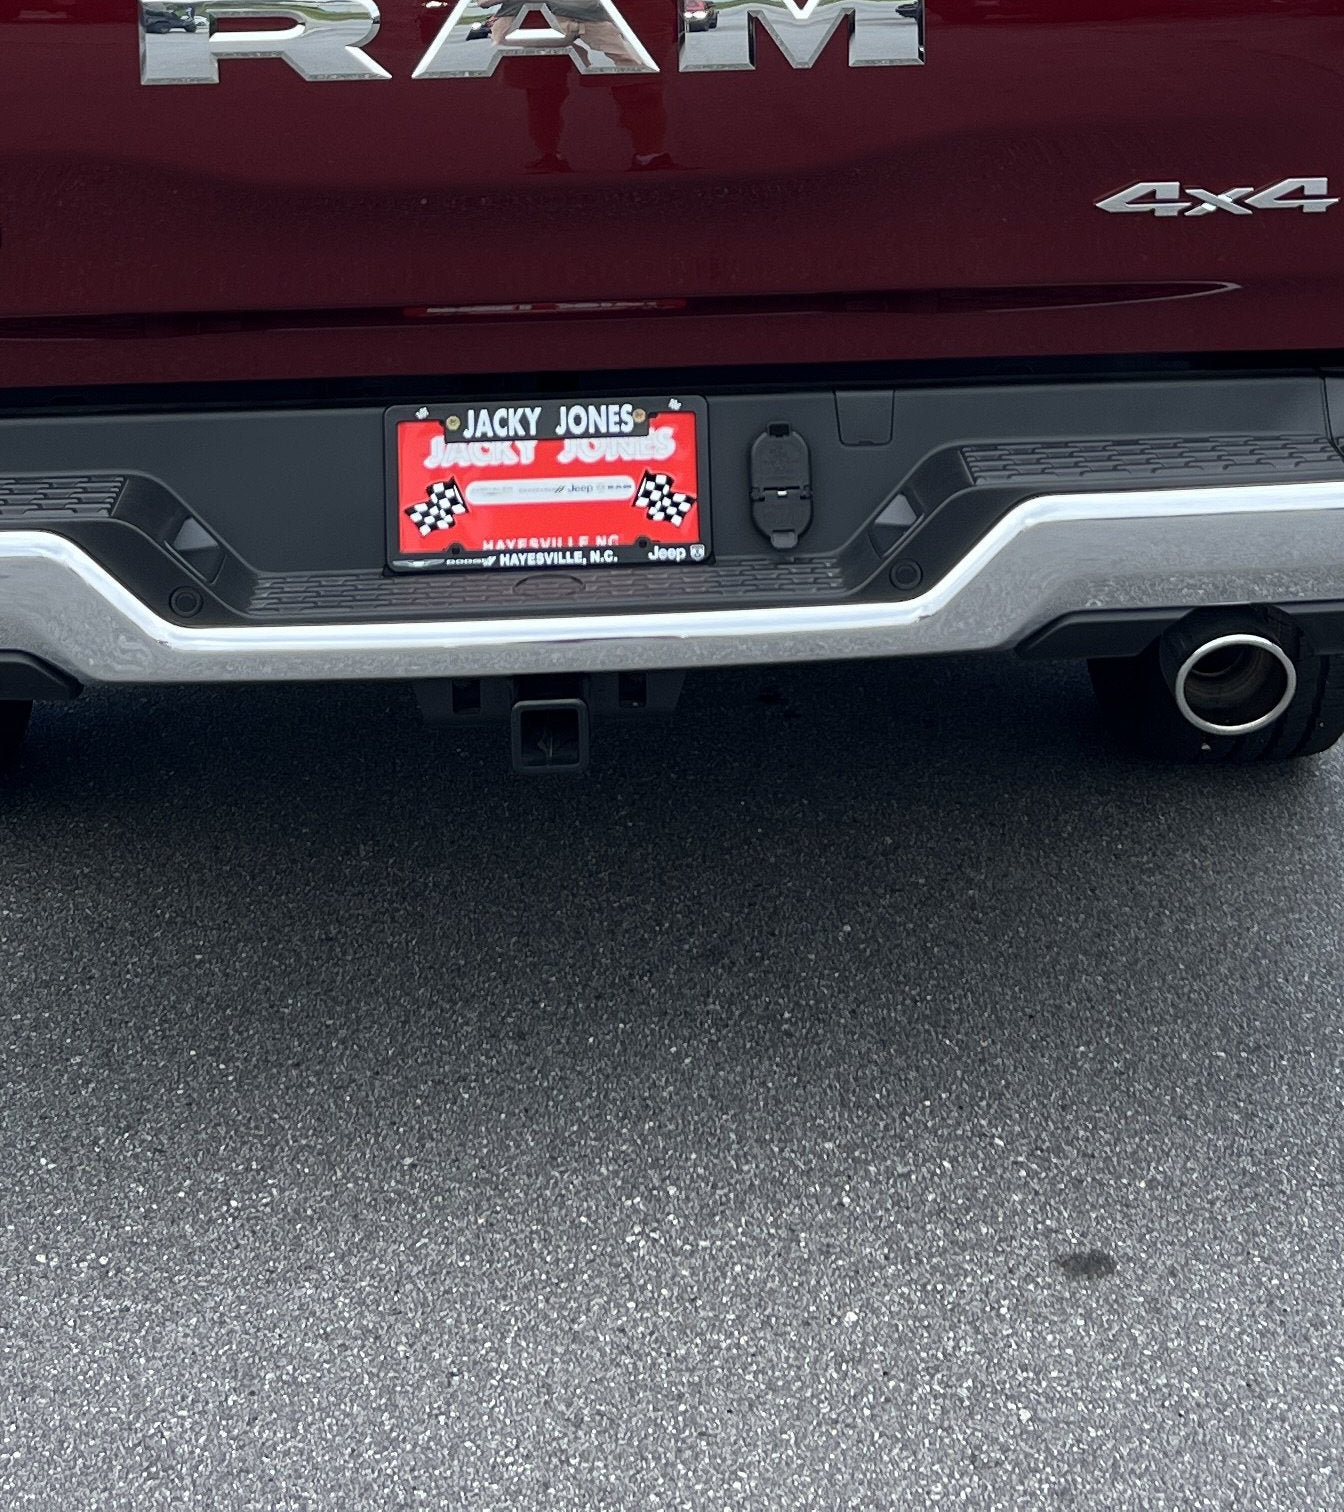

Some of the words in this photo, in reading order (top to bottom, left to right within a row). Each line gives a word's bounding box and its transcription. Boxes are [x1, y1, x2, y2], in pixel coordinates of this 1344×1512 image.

[1094, 176, 1341, 217] 4x4
[463, 406, 542, 438] JACKY
[555, 403, 634, 435] JONES
[423, 436, 538, 469] JACKY
[557, 427, 677, 464] JONES
[567, 483, 594, 493] Jeep
[499, 551, 587, 567] HAYESVILLE,
[589, 550, 618, 564] N.C.
[648, 545, 686, 562] Jeep
